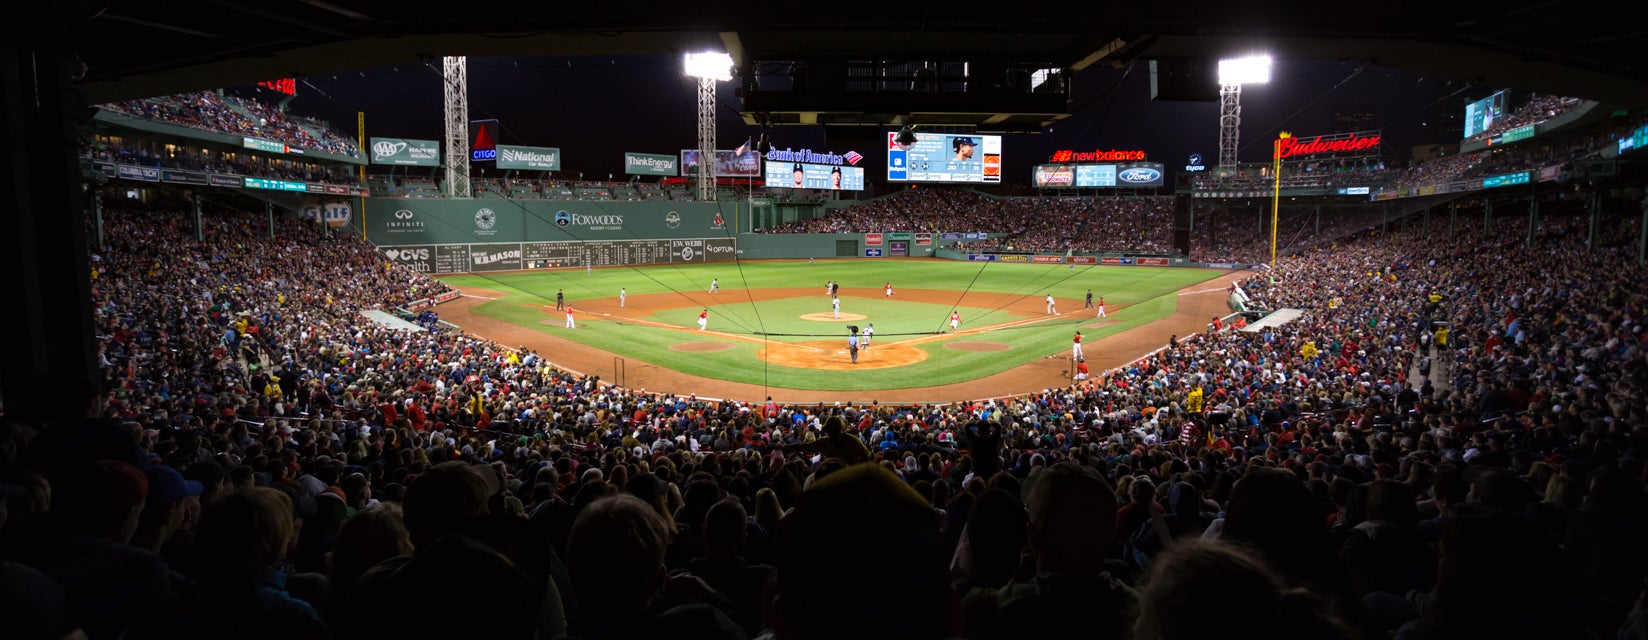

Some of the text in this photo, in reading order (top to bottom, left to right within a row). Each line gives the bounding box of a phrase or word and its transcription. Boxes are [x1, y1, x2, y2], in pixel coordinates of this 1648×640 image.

[377, 142, 396, 155] AAA
[1274, 133, 1381, 158] Budweiser
[473, 150, 496, 159] CITGO
[514, 151, 554, 163] National
[767, 146, 843, 165] Bank of America
[1073, 152, 1095, 161] new
[1095, 149, 1145, 162] balance
[627, 156, 673, 169] ThinkEnergy
[1127, 171, 1152, 180] Ford
[572, 213, 623, 225] FOXWOODS
[400, 248, 430, 261] CVS
[474, 250, 521, 265] W.B.MASON
